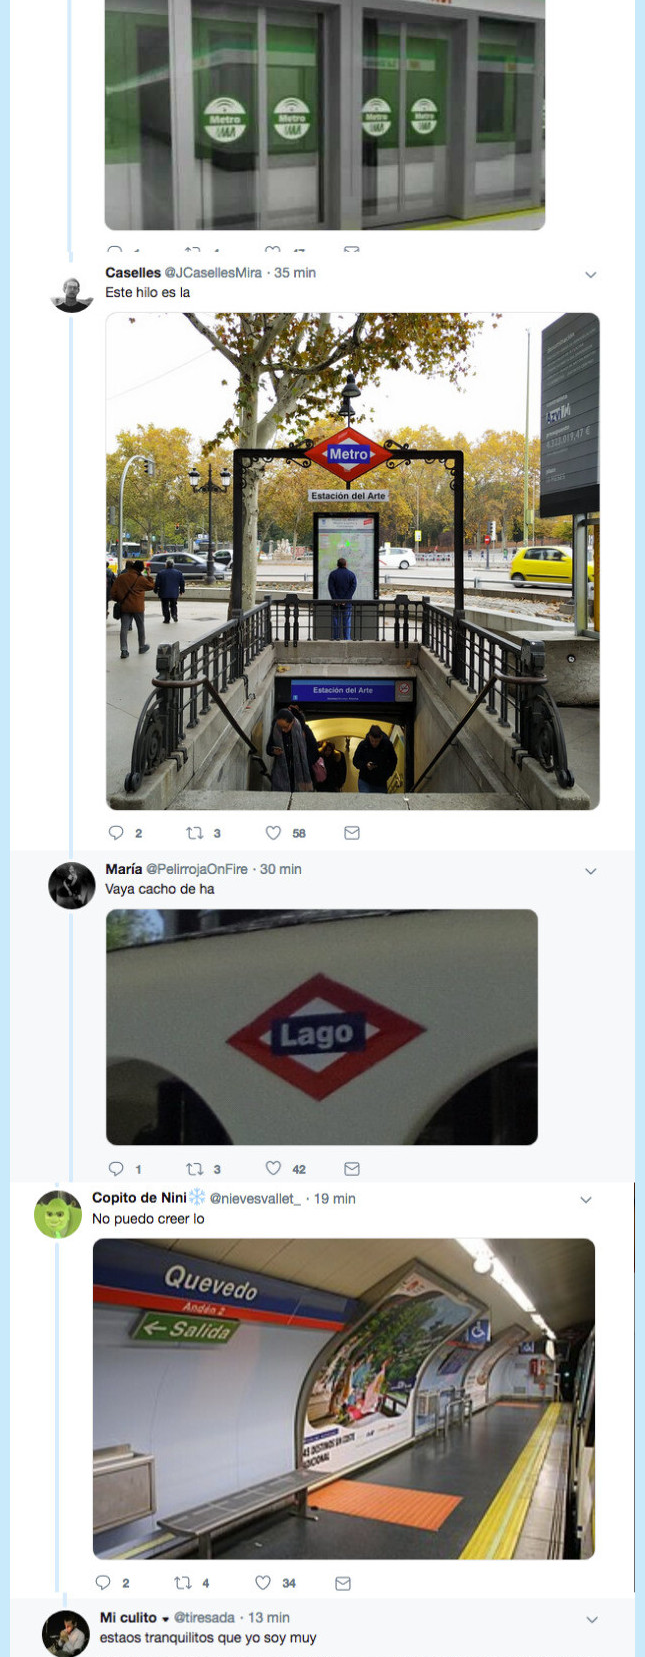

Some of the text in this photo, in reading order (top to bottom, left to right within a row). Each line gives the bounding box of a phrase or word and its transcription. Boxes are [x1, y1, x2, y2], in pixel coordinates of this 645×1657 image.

[209, 114, 241, 124] Metro
[278, 113, 306, 123] Metro
[365, 112, 388, 121] Metro
[414, 111, 435, 120] Metro
[104, 286, 190, 299] Este hilo es la
[329, 448, 368, 460] Metro
[311, 491, 386, 500] Estación del Arte
[313, 686, 343, 694] Estación
[345, 686, 357, 694] del
[280, 1023, 353, 1049] Lago
[91, 1211, 205, 1228] No puedo creer lo
[164, 1264, 258, 1301] Quevedo
[182, 1301, 216, 1315] Andén
[169, 1320, 231, 1340] Salida
